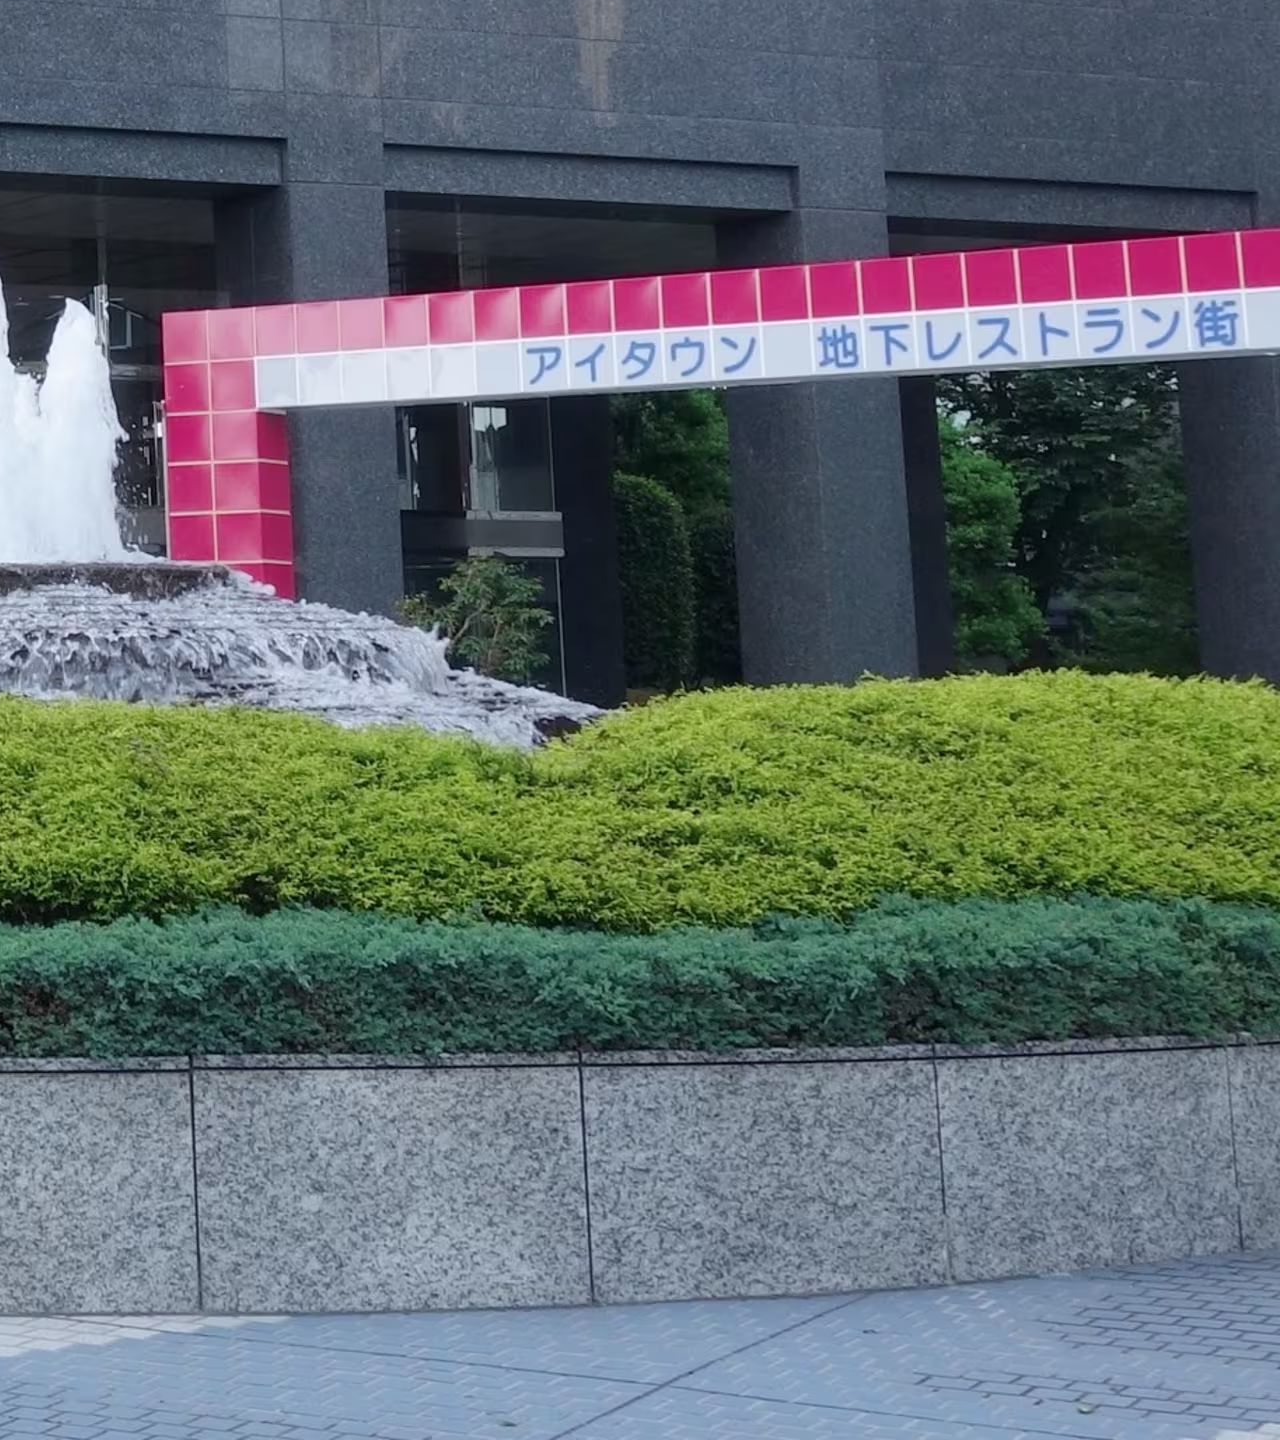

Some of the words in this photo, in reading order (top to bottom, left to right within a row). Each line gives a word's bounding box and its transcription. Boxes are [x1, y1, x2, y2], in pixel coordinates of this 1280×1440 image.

[526, 336, 757, 385] アイタウン
[817, 299, 1238, 368] 地下レストラン街
